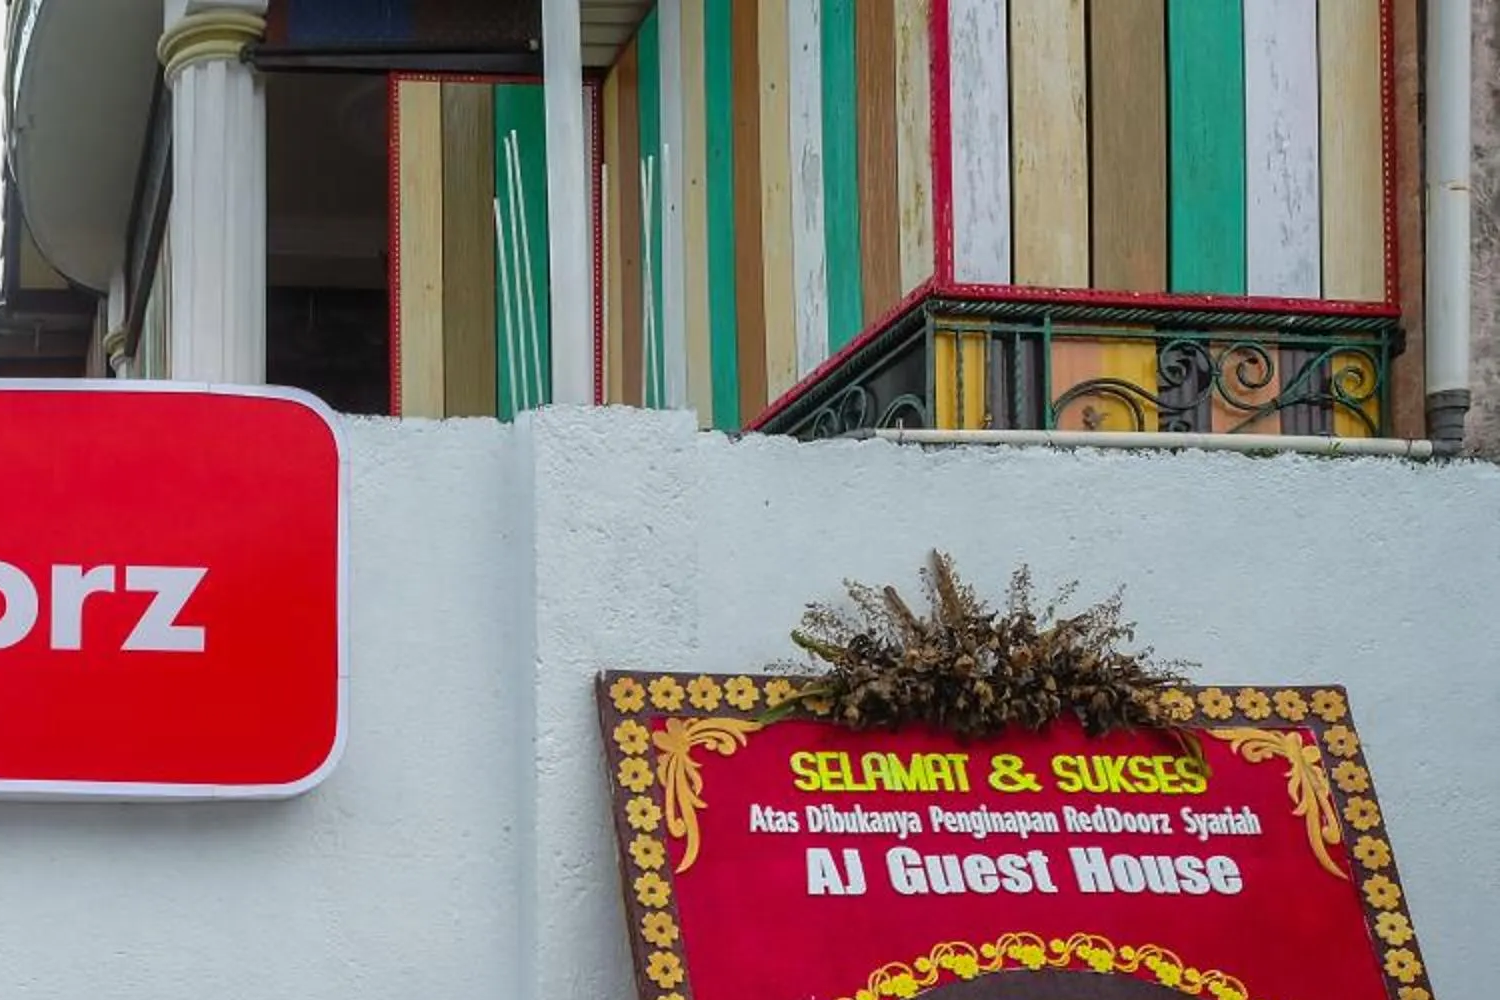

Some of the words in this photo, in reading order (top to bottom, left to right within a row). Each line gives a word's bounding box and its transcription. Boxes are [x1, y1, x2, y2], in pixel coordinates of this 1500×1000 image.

[791, 752, 972, 793] SELAMAT
[988, 752, 1043, 792] &
[1053, 754, 1208, 794] SUKSES
[749, 804, 799, 833] Atas
[807, 804, 922, 840] Dibukanya
[930, 805, 1059, 840] Penginapan
[1062, 804, 1173, 834] RedDoorz
[1180, 806, 1262, 841] Syariah
[806, 846, 866, 895] AJ
[886, 846, 1057, 895] Guest
[1071, 847, 1243, 895] House
